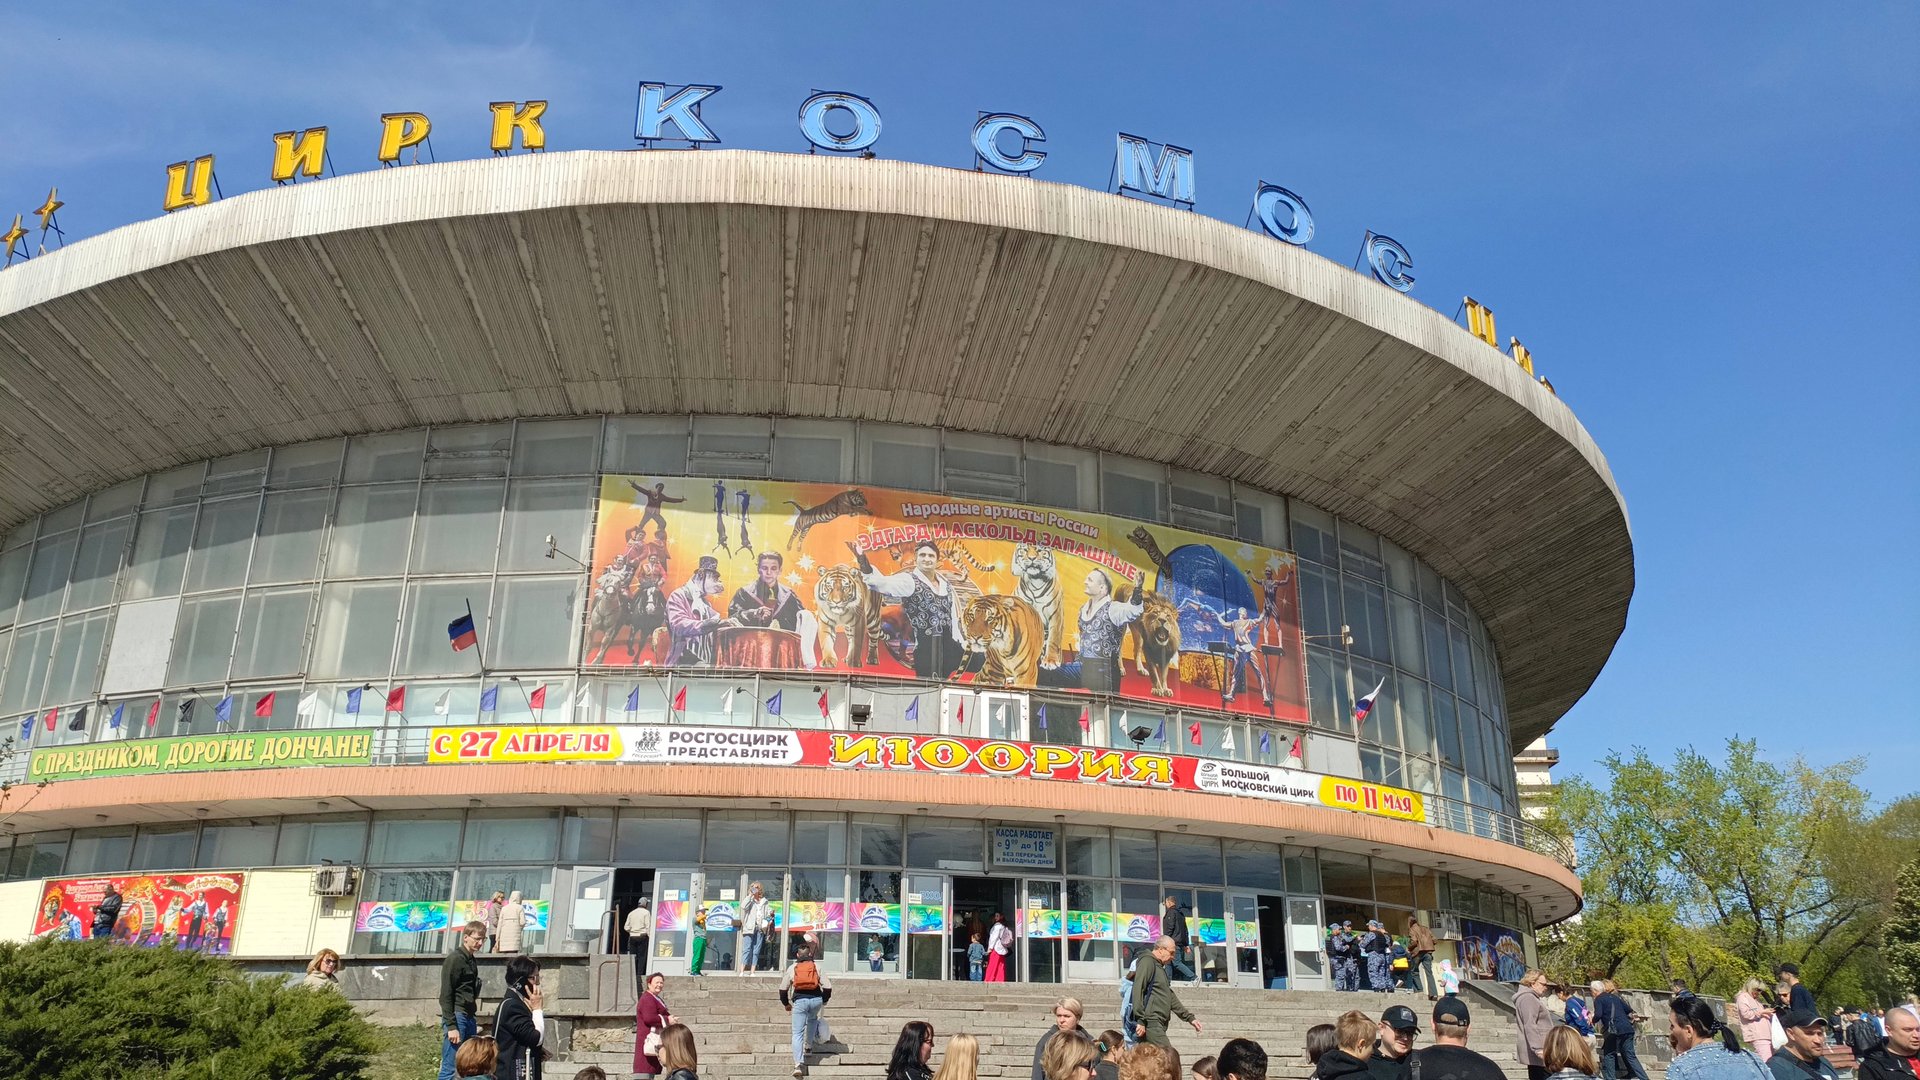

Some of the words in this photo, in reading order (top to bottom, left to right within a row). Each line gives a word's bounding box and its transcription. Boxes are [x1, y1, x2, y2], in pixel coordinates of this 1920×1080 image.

[163, 101, 549, 212] ЦИРК
[635, 81, 1415, 294] КОСМОС
[901, 503, 980, 519] Народные
[984, 506, 1044, 523] артисты
[1048, 513, 1099, 538] России
[858, 525, 930, 551] ЭДГАРД
[933, 523, 947, 538] И
[951, 522, 1037, 545] АСКОЛЬД
[1041, 532, 1136, 582] ЗАПАШНЫЕ
[434, 735, 450, 755] С
[459, 731, 497, 757] 27
[504, 733, 609, 752] АПРЕЛЯ
[669, 731, 788, 747] РОСГОСЦИРК
[32, 754, 44, 776] С
[47, 745, 161, 775] ПРАЗДНИКОМ,
[165, 740, 254, 768] ДОРОГИЕ
[260, 734, 370, 761] ДОНЧАНЕ!
[667, 747, 789, 760] ПРЕДСТАВЛЯЕТ
[1220, 767, 1270, 782] БОЛЬШОЙ
[1221, 779, 1288, 795] МОСКОВСКИЙ
[1290, 787, 1315, 800] ЦИРК
[1335, 785, 1357, 803] ПО
[1361, 786, 1377, 810] 11
[1383, 793, 1412, 813] МАЯ
[996, 828, 1018, 838] КАССА
[1020, 830, 1053, 840] РАБОТАЕТ
[802, 904, 826, 924] 55
[1081, 913, 1103, 933] 55
